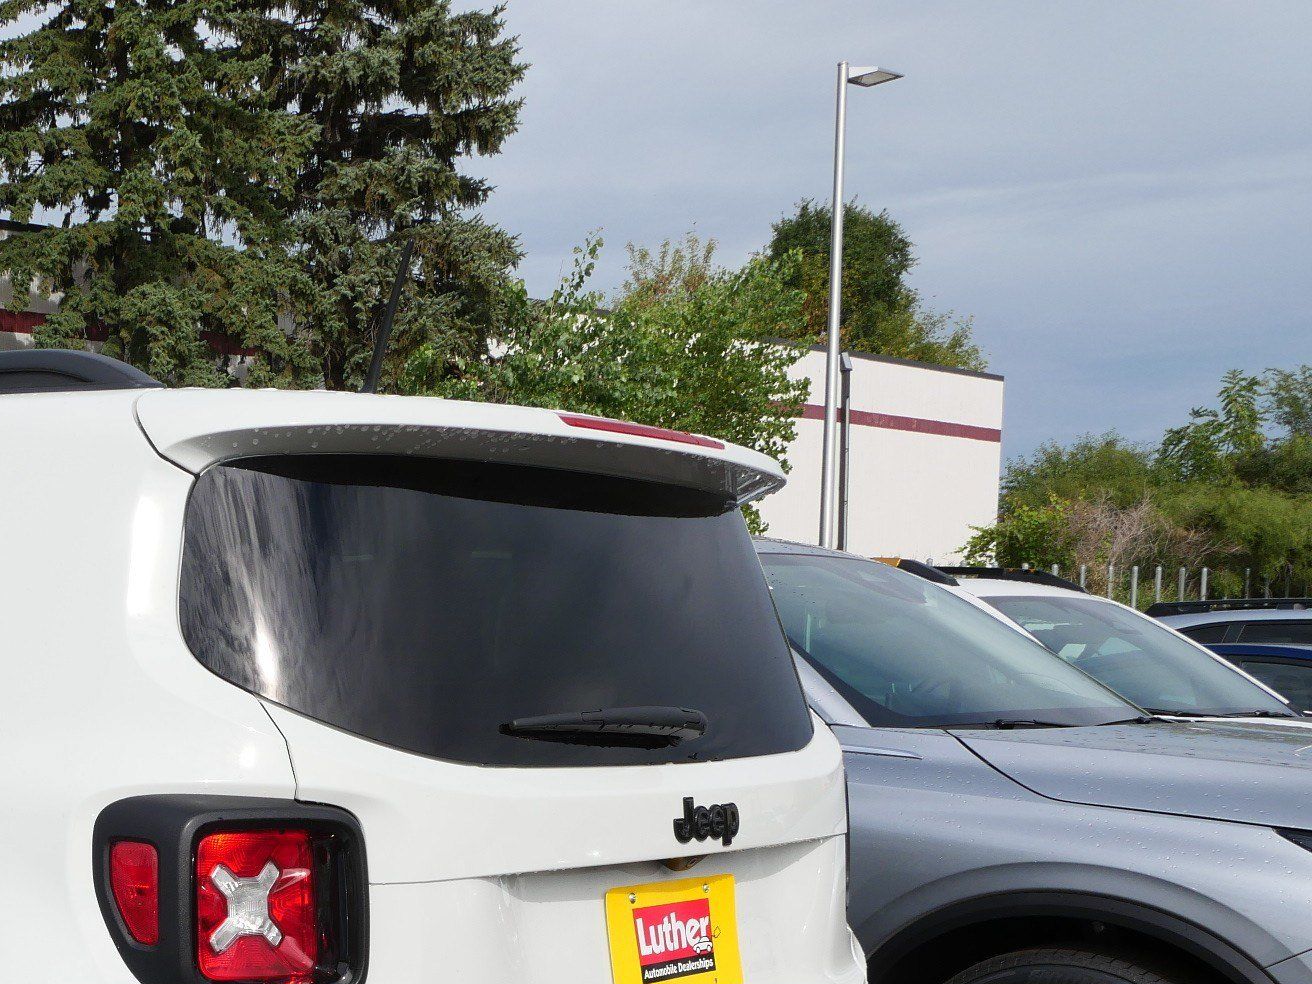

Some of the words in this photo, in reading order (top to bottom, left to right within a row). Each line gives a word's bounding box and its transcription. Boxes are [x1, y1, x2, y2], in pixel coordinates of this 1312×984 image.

[673, 797, 739, 846] Jeep
[636, 912, 710, 957] Luther
[644, 964, 678, 980] Automobile
[678, 958, 714, 974] Dealerships
